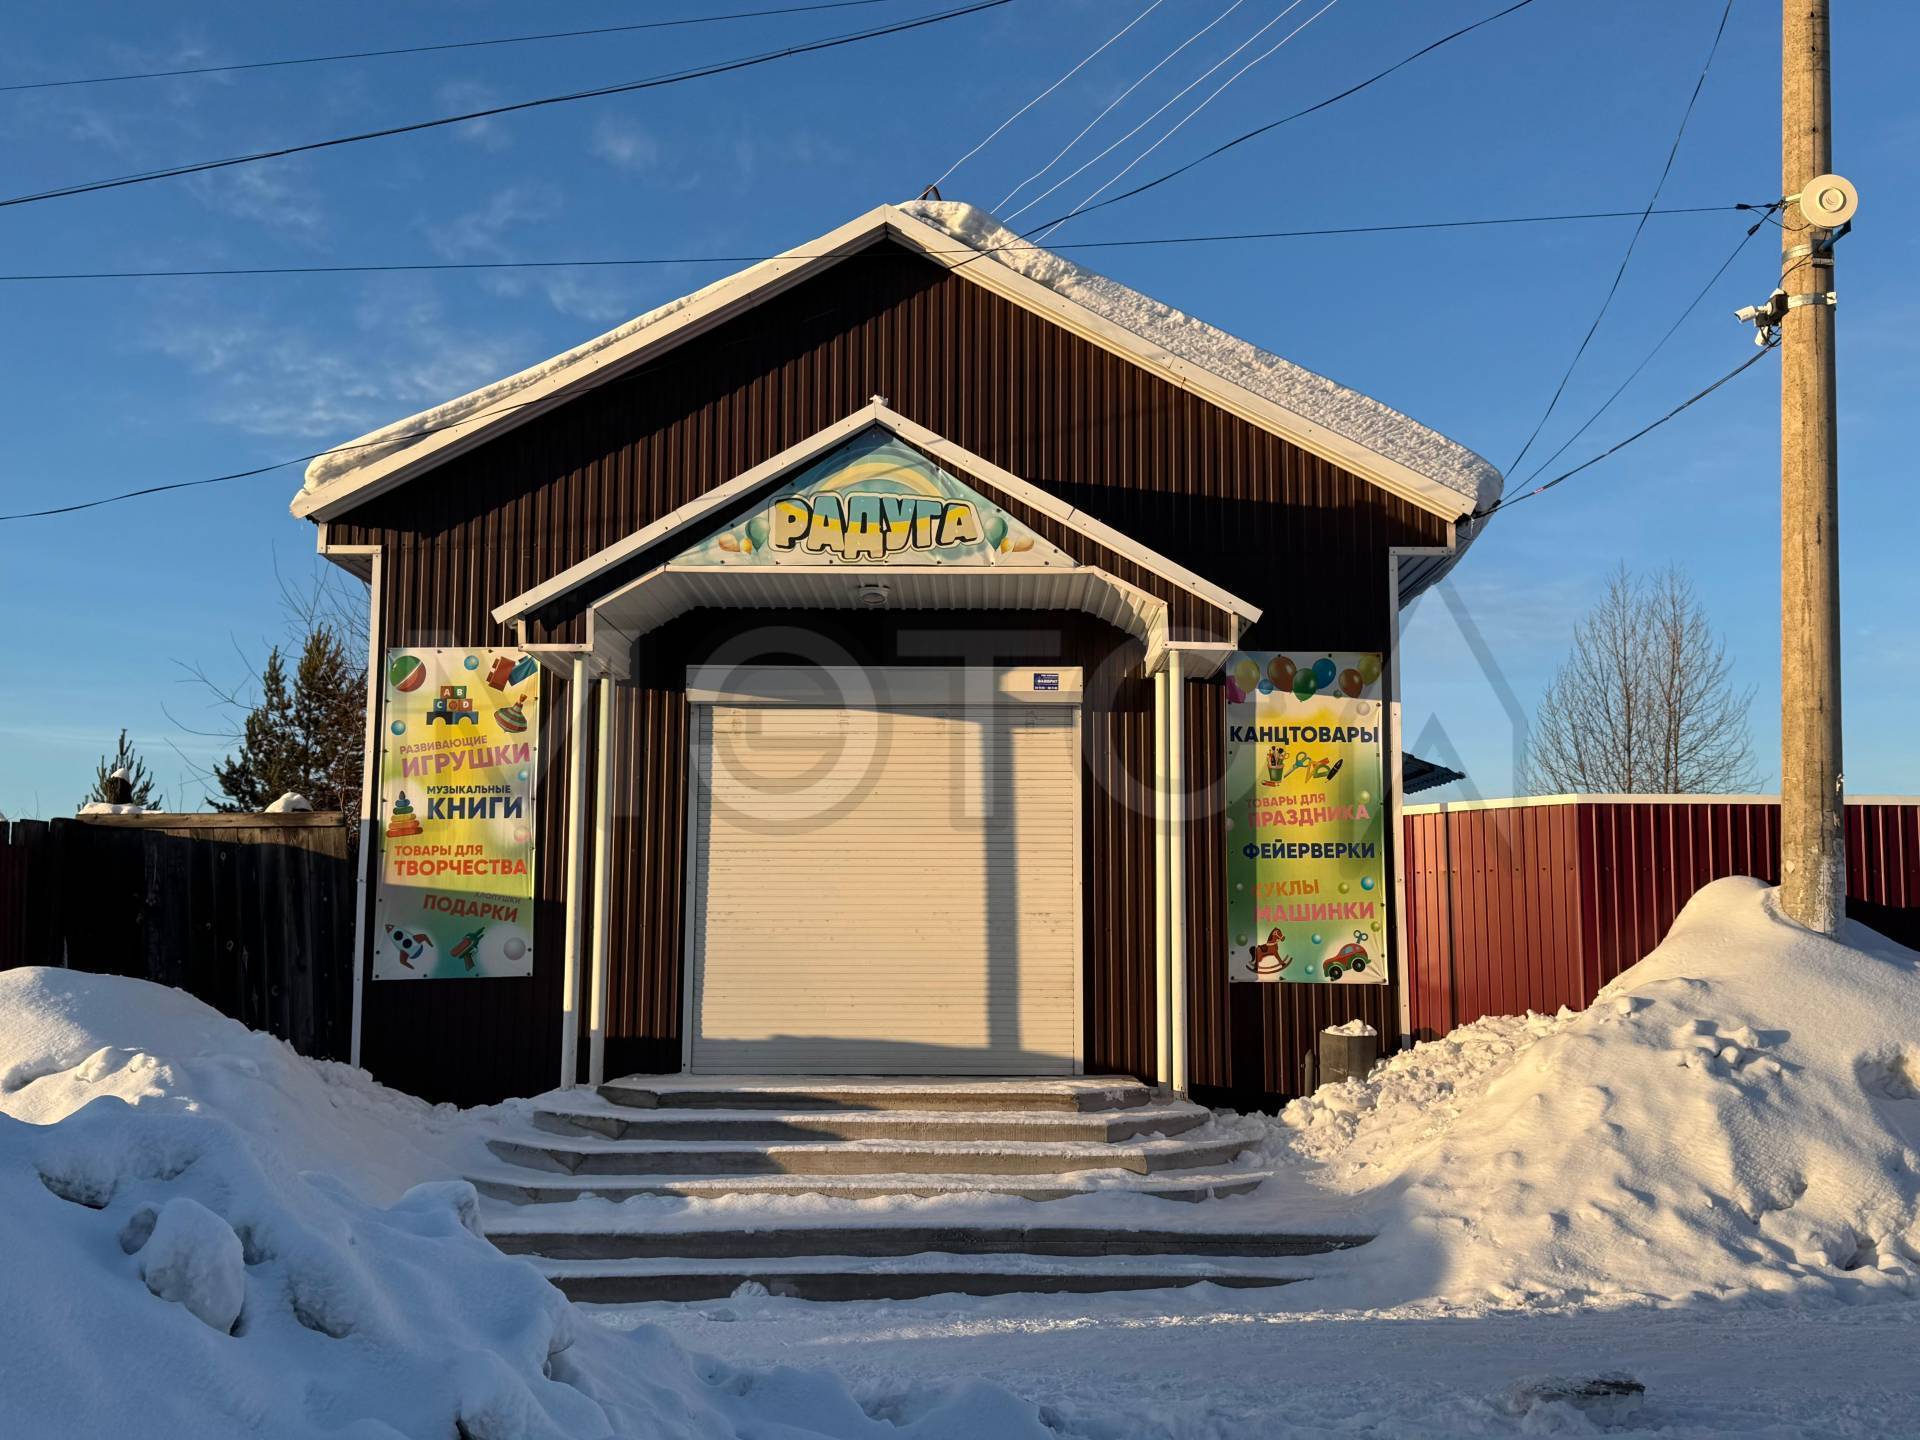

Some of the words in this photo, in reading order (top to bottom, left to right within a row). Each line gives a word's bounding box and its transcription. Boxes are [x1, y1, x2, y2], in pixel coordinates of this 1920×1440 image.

[771, 493, 981, 560] РАДУГА
[400, 735, 488, 754] РАЗВИВАЮЩИЕ
[1230, 725, 1378, 745] КАНЦТОВАРЫ
[401, 742, 531, 778] ИГРУШКИ
[427, 784, 511, 795] МУЗЫКАЛЬНЫЕ
[427, 796, 523, 820] КНИГИ
[1248, 795, 1297, 808] ТОВАРЫ
[1300, 792, 1326, 806] ДЛЯ
[1248, 803, 1371, 829] ПРАЗДНИКА
[394, 845, 452, 856] ТОВАРЫ
[454, 845, 483, 857] ДЛЯ
[1243, 839, 1375, 859] ФЕЙЕРВЕРКИ
[394, 858, 527, 876] ТВОРЧЕСТВА
[1250, 879, 1319, 897] КУКЛЫ
[423, 894, 518, 923] ПОДАРКИ
[1254, 901, 1375, 923] МАШИНКИ
